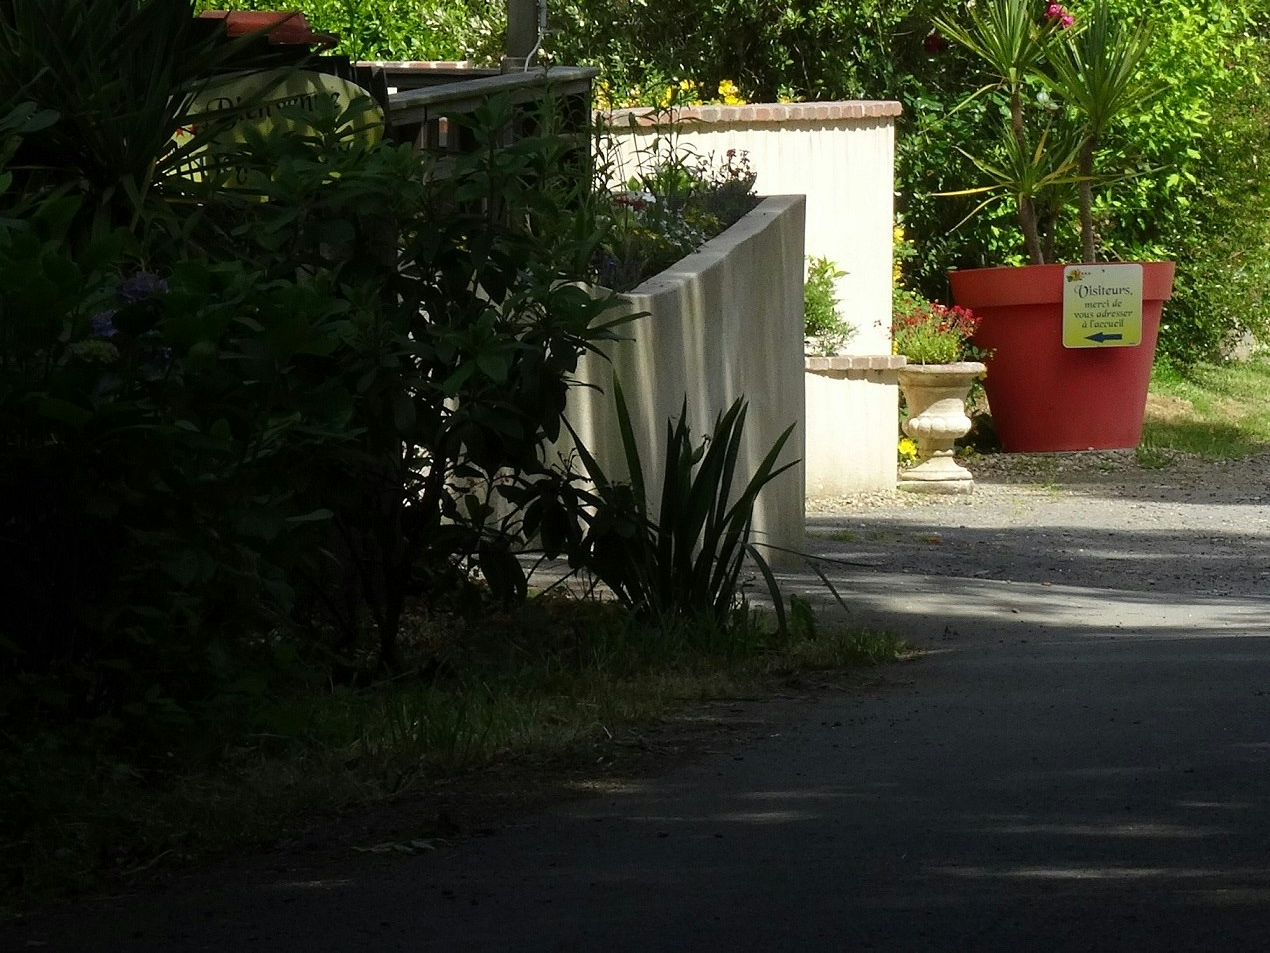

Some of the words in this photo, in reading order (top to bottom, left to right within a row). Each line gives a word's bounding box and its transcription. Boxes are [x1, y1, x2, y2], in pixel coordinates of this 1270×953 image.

[1073, 285, 1133, 298] Visiteurs,
[1084, 300, 1109, 308] merci
[1112, 299, 1122, 308] de
[1073, 311, 1094, 319] vous
[1096, 309, 1133, 318] adresser
[1081, 319, 1088, 328] à
[1089, 319, 1124, 328] l'accueil
